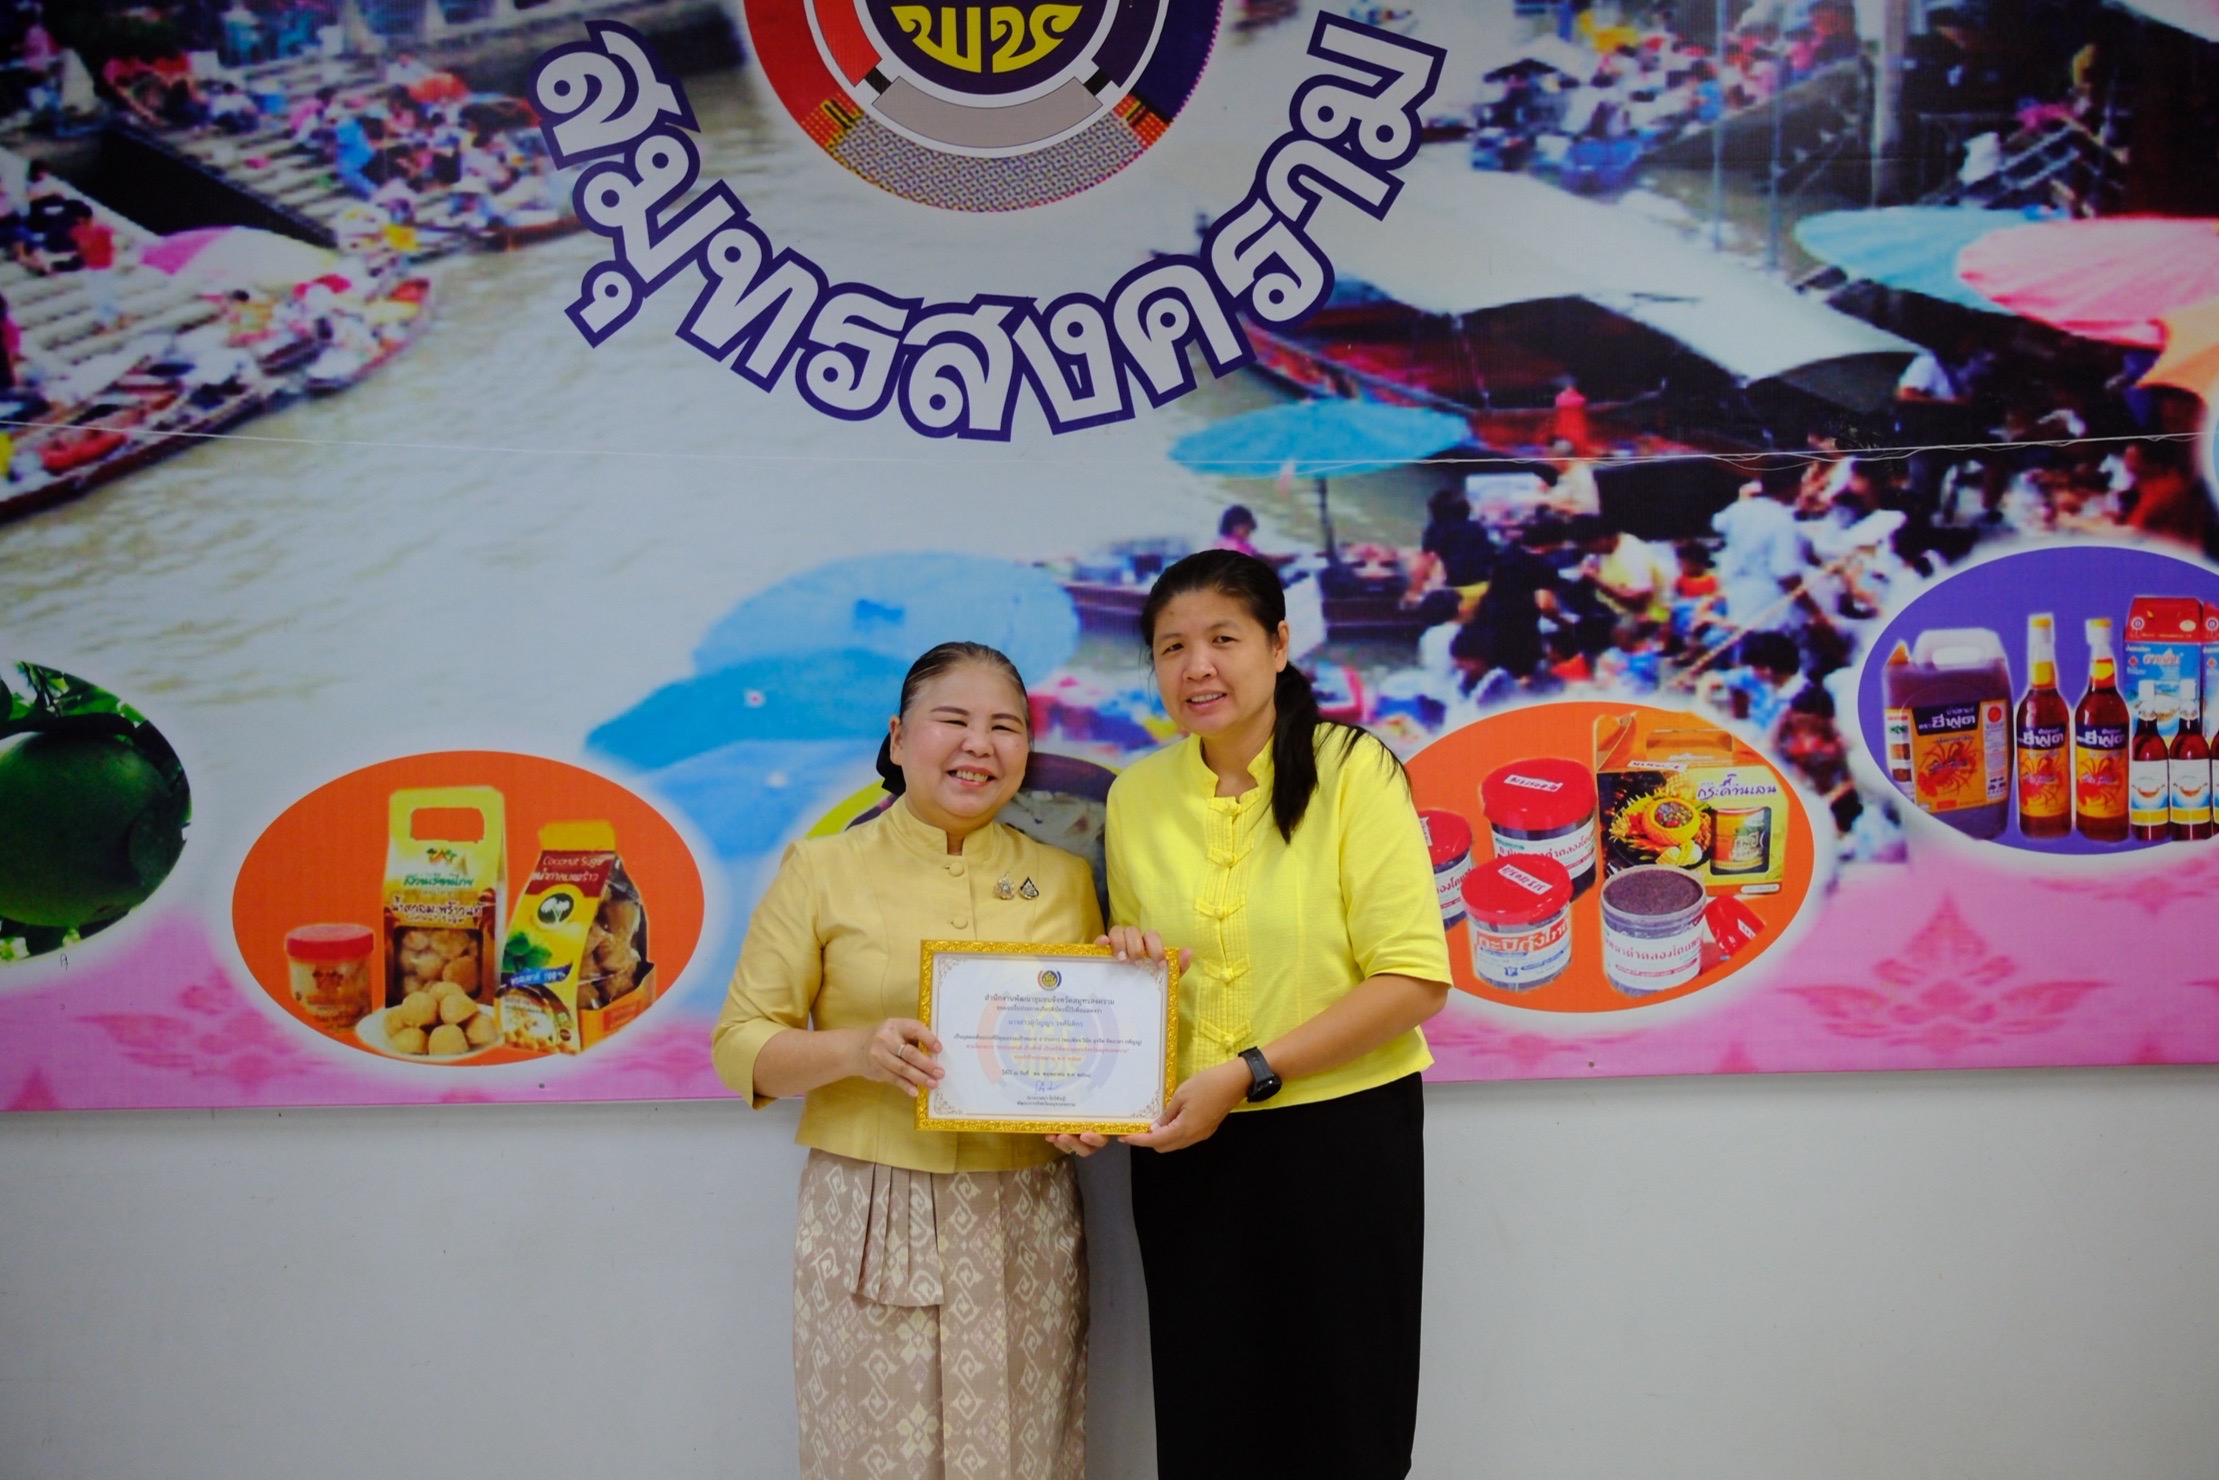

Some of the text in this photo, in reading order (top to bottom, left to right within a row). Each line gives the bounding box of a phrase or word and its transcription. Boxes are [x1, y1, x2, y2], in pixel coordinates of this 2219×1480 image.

[526, 10, 1448, 443] สมุทรสงคราม
